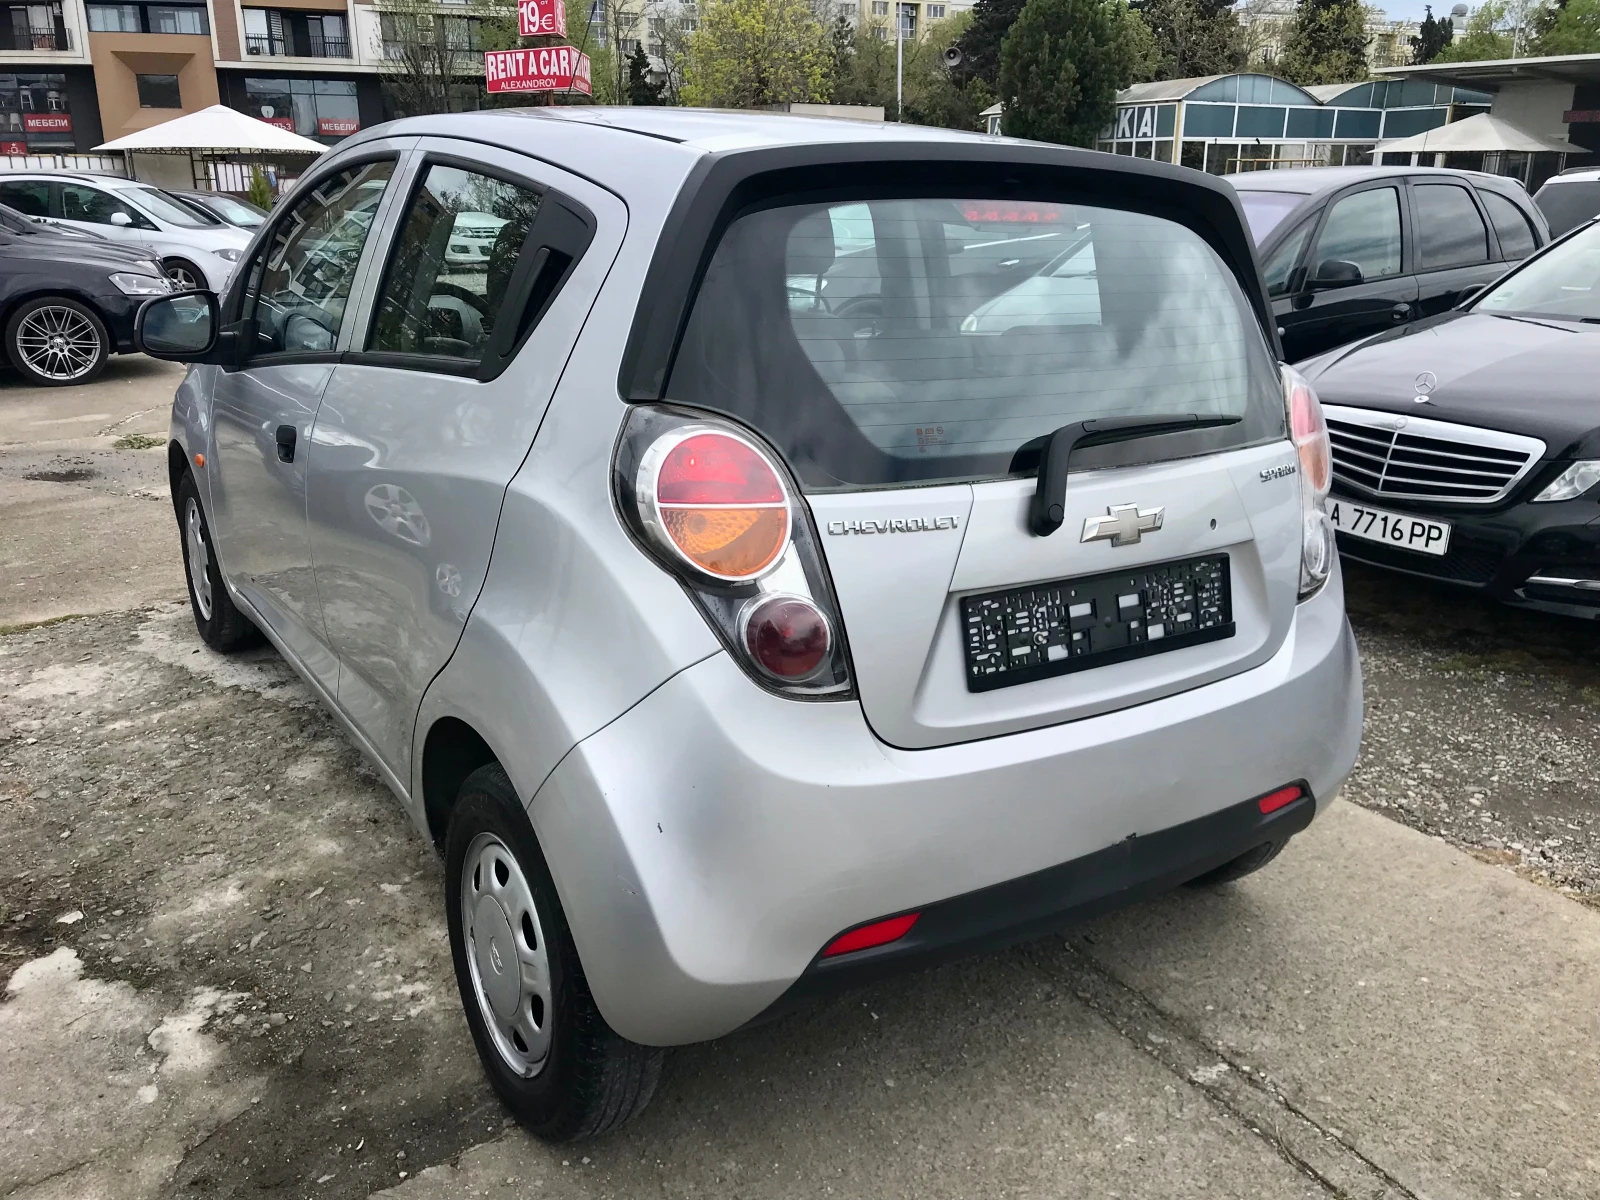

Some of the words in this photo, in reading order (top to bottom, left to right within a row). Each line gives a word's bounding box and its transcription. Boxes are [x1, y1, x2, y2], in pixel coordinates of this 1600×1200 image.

[487, 52, 525, 82] RENT
[528, 51, 538, 76] A
[539, 49, 571, 77] CAR
[500, 78, 557, 90] ALEXANDROV
[27, 119, 69, 127] МЕБЕЛИ
[321, 122, 357, 131] МЕБЕЛИ
[827, 514, 960, 536] CHEVROLET
[1330, 502, 1340, 527] A
[1350, 507, 1405, 541] 7716
[1408, 521, 1443, 548] PP
